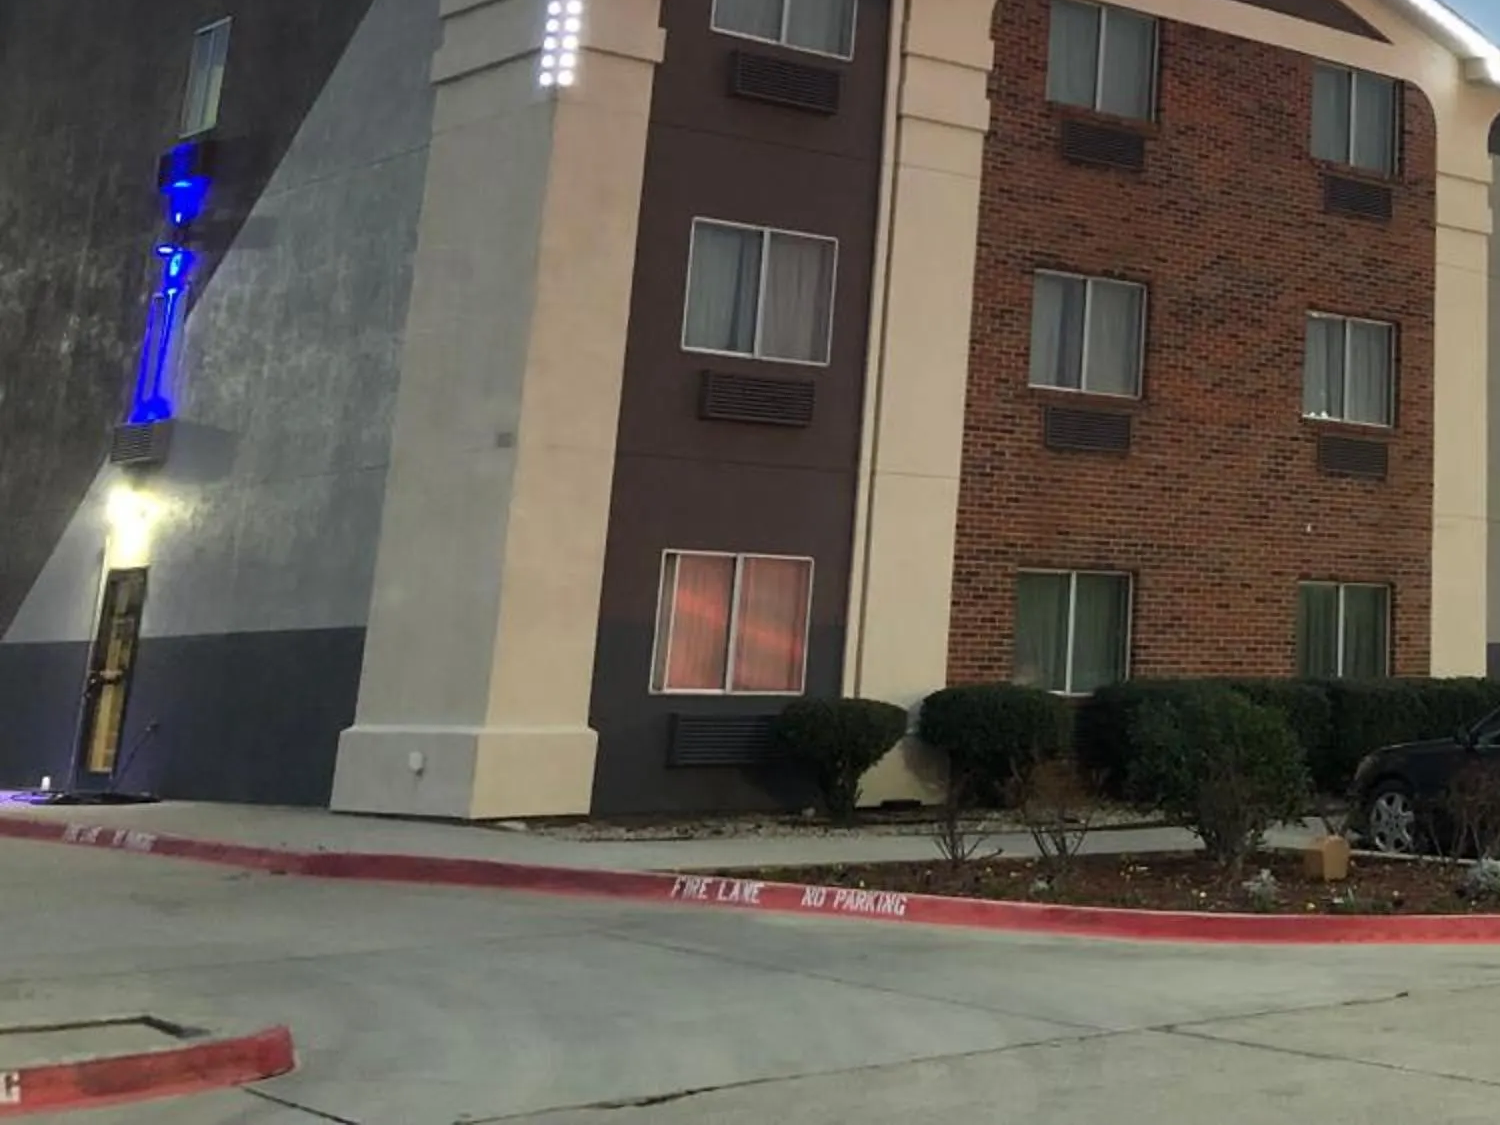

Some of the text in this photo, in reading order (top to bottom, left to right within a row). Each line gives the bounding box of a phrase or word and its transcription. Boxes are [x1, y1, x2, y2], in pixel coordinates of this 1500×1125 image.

[670, 875, 908, 915] FIRE LANE NO PARKING
